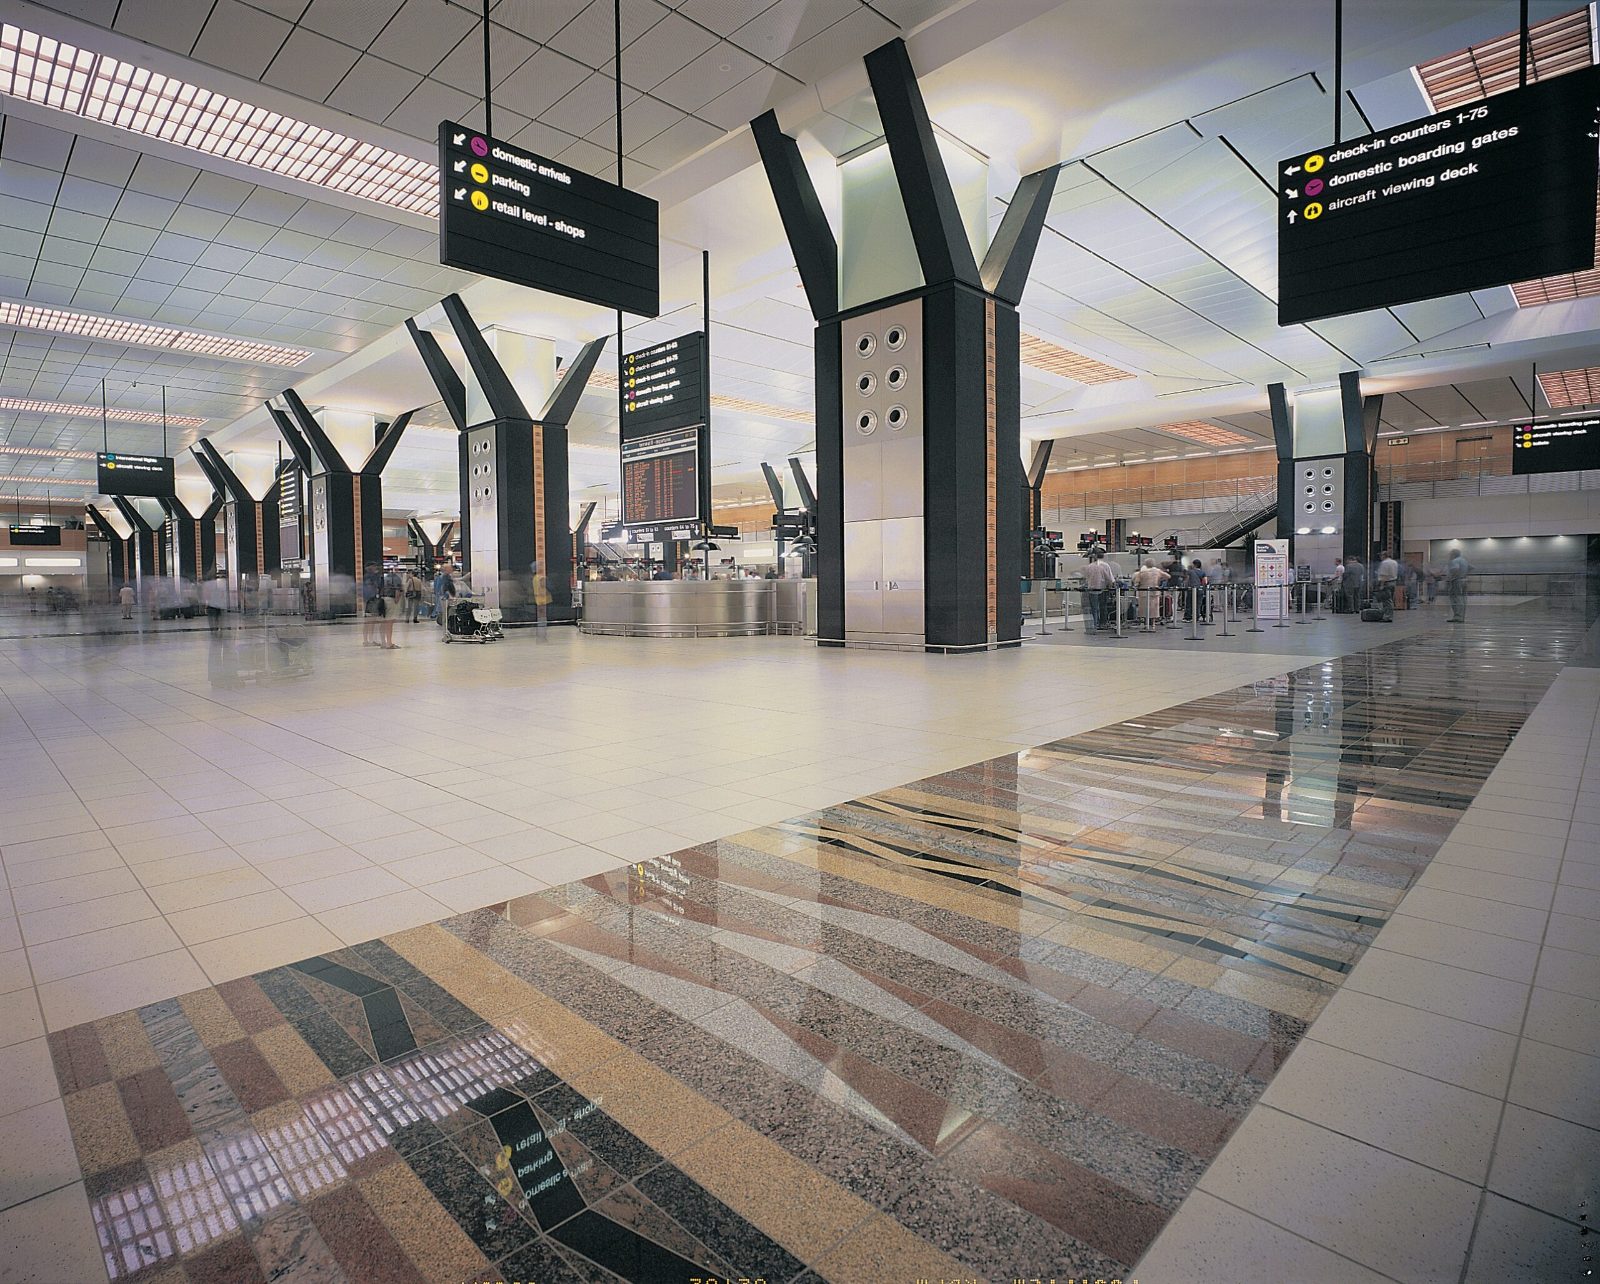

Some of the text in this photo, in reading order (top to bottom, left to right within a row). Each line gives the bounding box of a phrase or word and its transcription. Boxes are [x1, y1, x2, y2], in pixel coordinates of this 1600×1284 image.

[1329, 105, 1489, 163] check-in counters 1-75
[492, 147, 571, 184] domestic arrivals
[1329, 124, 1519, 188] domestic boarding gates
[492, 174, 530, 196] parking
[1328, 162, 1479, 211] aircraft viewing deck
[492, 200, 520, 217] retail
[522, 208, 547, 226] level
[555, 221, 585, 238] shops
